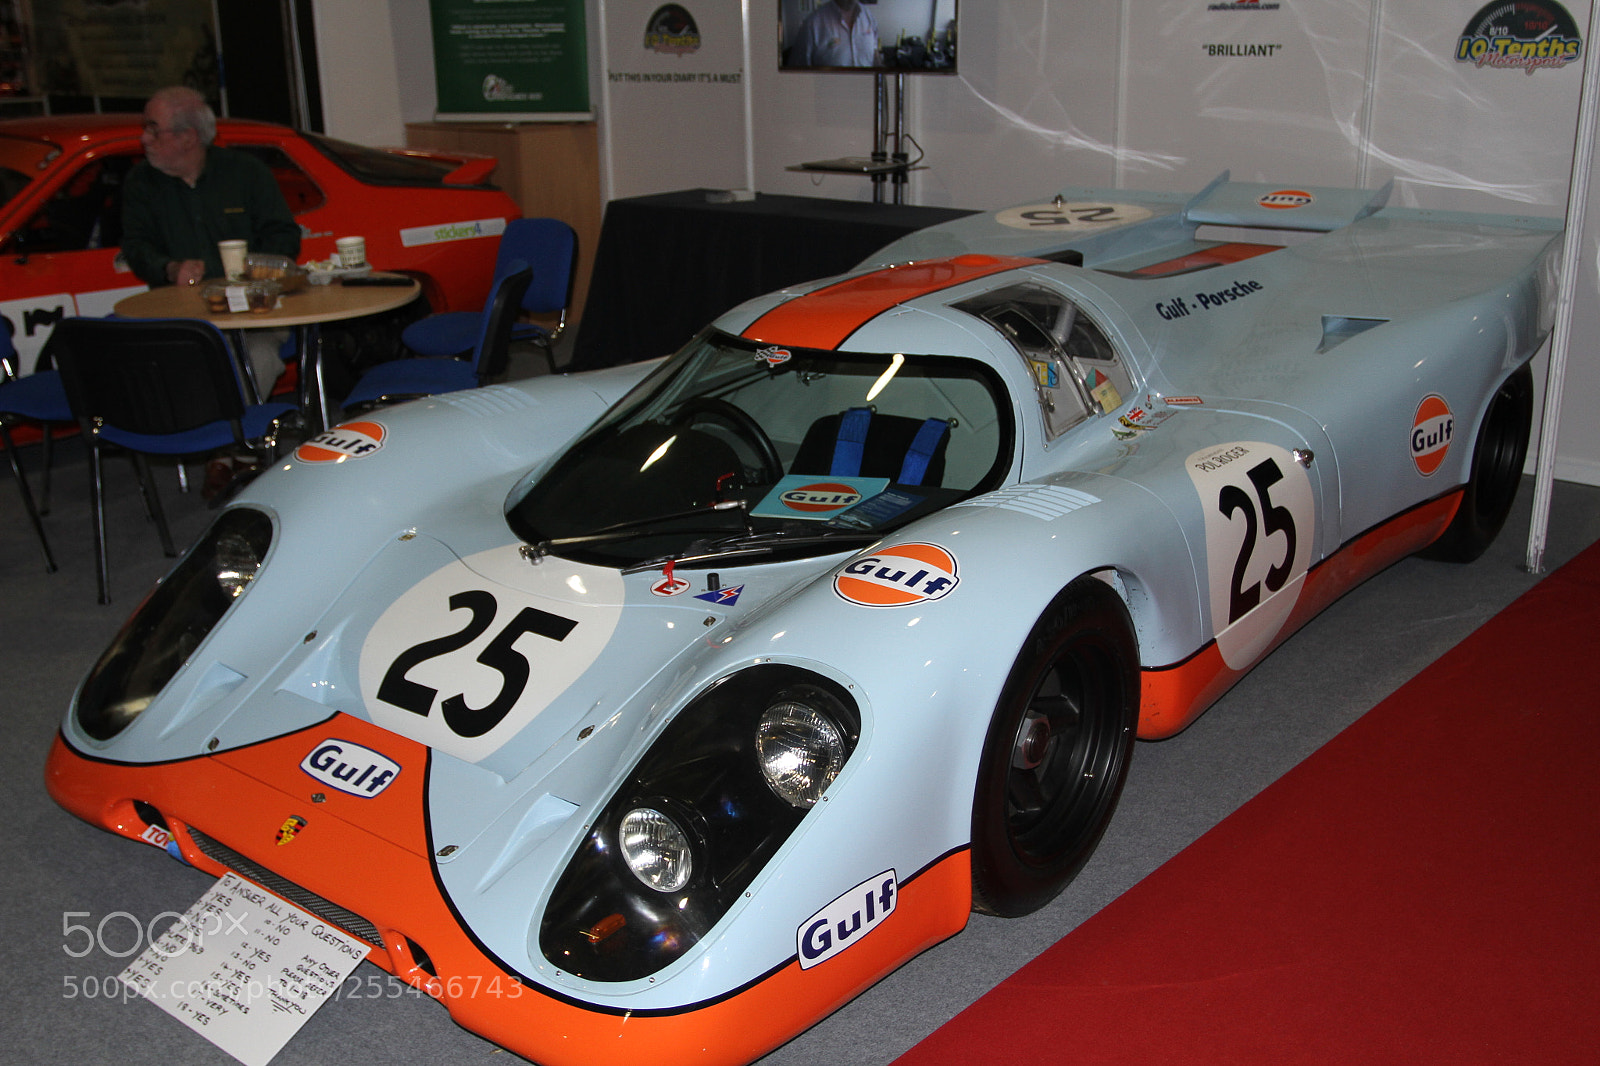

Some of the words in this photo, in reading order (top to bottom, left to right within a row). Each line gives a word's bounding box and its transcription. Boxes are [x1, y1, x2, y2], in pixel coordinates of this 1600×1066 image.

[1489, 26, 1509, 36] 8/10
[1478, 53, 1572, 74] Motorsport
[1493, 37, 1580, 59] Tenths
[1020, 206, 1124, 227] 25
[1155, 299, 1188, 321] Gulf
[1196, 277, 1264, 311] Porsche
[1412, 419, 1453, 453] Gulf
[1195, 460, 1222, 473] POL
[1212, 446, 1250, 465] ROGER
[784, 491, 858, 504] Gulf
[1219, 457, 1297, 625] 25
[844, 558, 952, 596] Gulf
[376, 589, 580, 738] 25
[309, 745, 394, 793] Gulf
[264, 902, 283, 917] ALL
[279, 912, 309, 931] YOUR
[801, 878, 894, 960] Gulf
